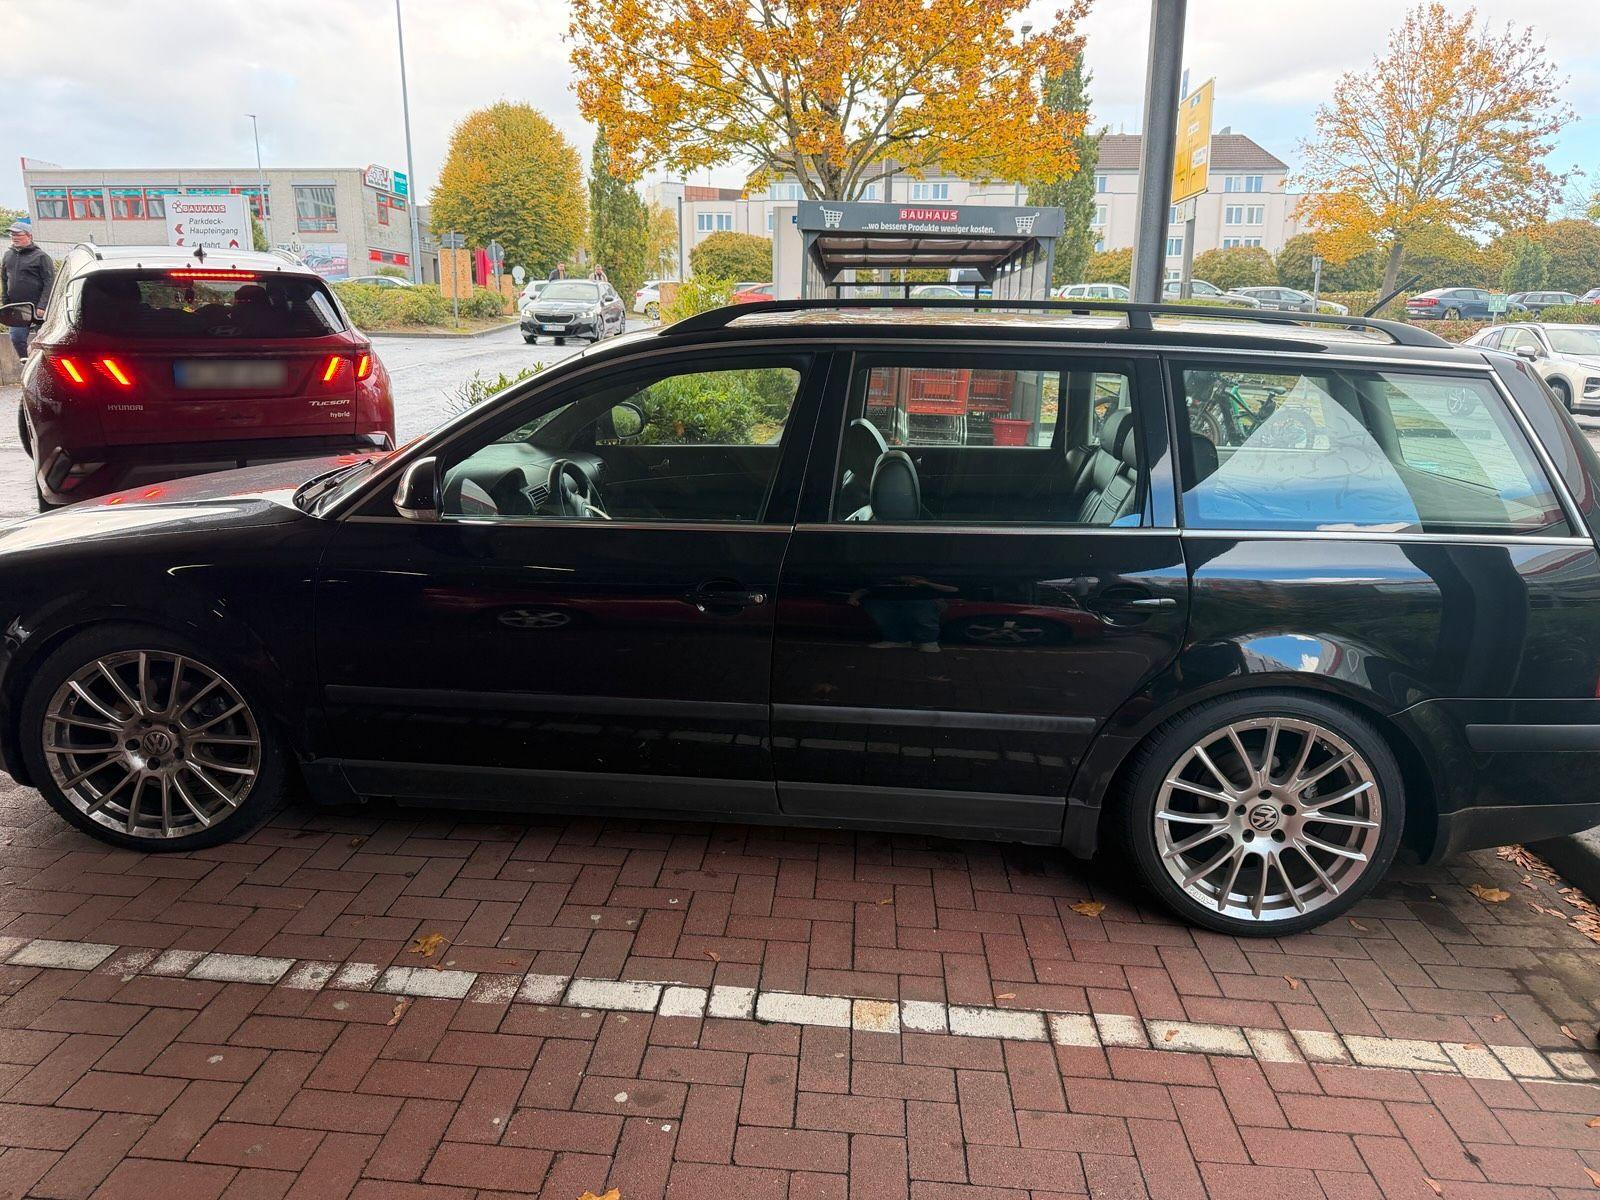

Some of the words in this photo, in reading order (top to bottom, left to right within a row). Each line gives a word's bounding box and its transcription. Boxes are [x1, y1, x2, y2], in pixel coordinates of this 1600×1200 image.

[182, 204, 226, 213] BAUHAUS
[901, 210, 958, 220] BAUHAUS
[881, 222, 907, 231] bessere
[908, 224, 939, 232] Produkte
[940, 225, 969, 234] weniger
[970, 224, 996, 234] kosten.
[330, 410, 350, 418] hybrid
